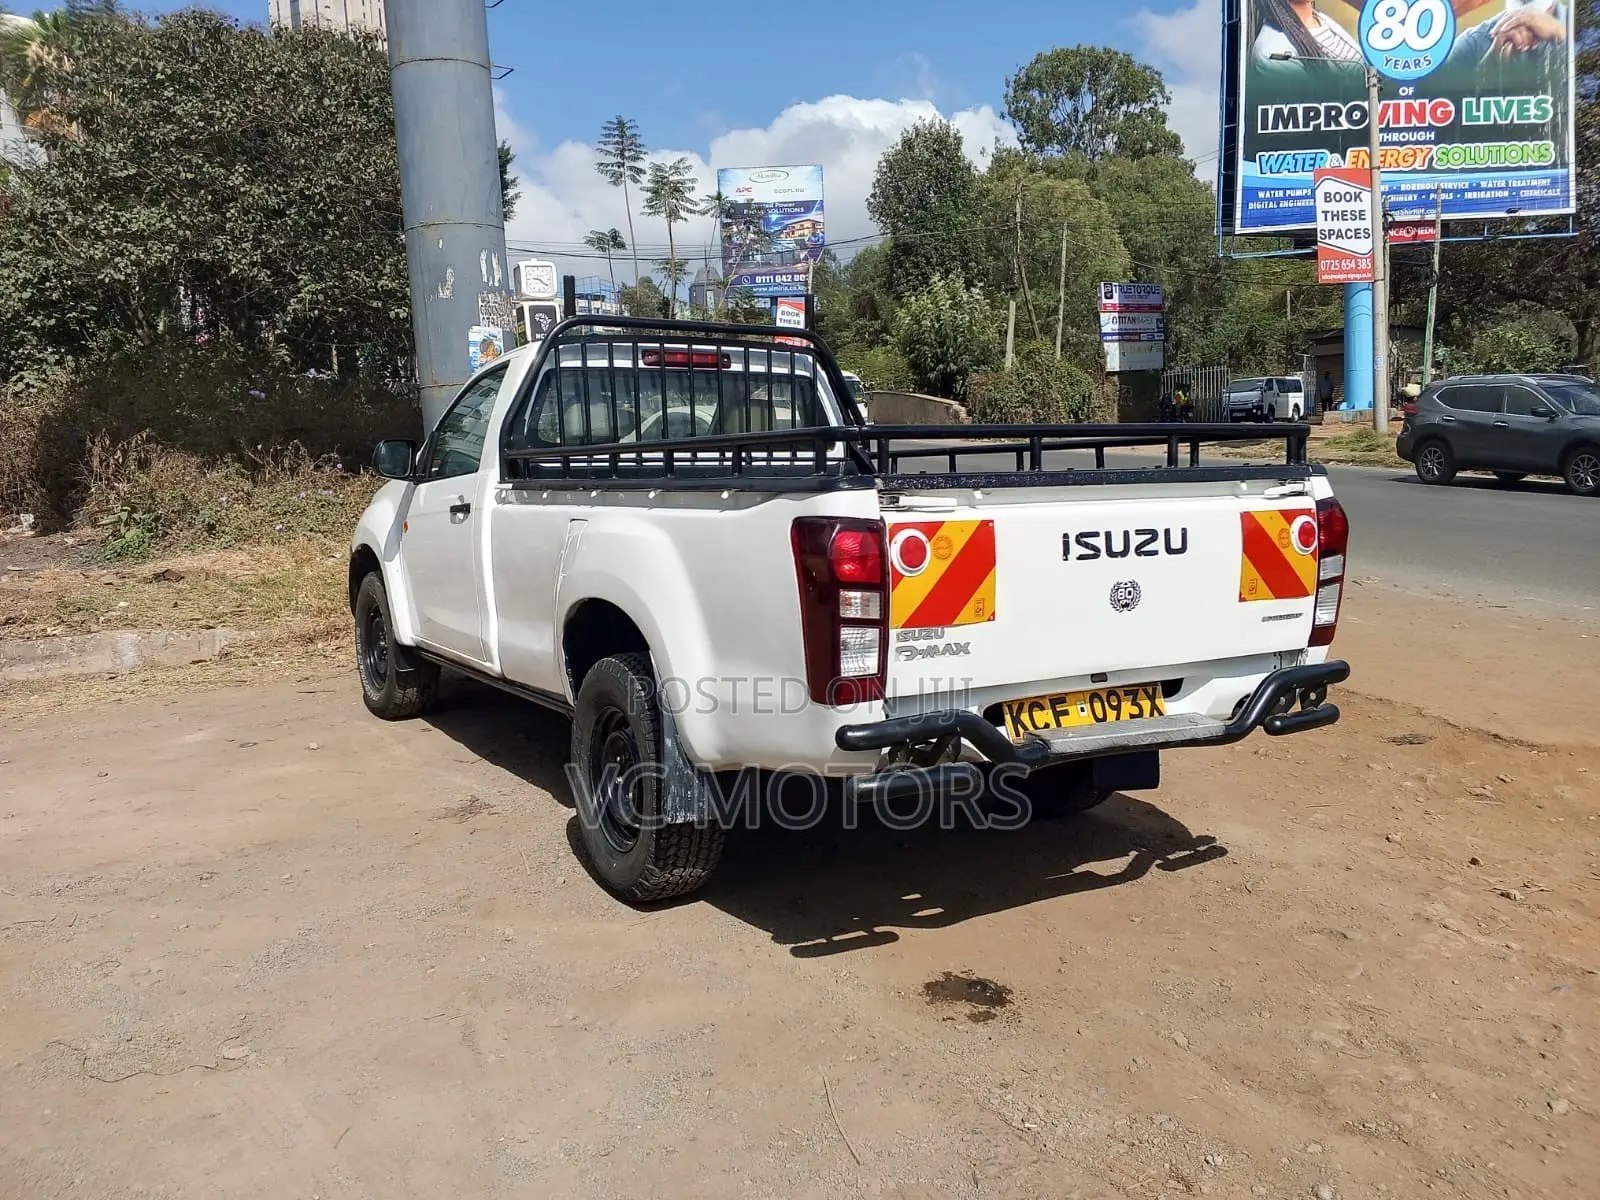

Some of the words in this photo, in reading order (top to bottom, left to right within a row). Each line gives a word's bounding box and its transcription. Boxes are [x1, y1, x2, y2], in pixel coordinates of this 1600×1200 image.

[1367, 0, 1449, 51] 80
[1383, 54, 1432, 71] YEARS
[1398, 86, 1415, 97] OF
[1463, 96, 1554, 124] LIVES
[1379, 131, 1435, 142] THROUGH
[1258, 151, 1329, 174] WATER
[1330, 154, 1342, 167] &
[1347, 147, 1432, 169] ENERGY
[1436, 143, 1554, 167] SOLUTIONS
[1257, 190, 1284, 199] WATER
[1285, 188, 1312, 197] PUMPS
[1480, 180, 1506, 188] WATER
[1248, 200, 1278, 209] DIGITAL
[1429, 192, 1454, 200] POLS
[1464, 190, 1509, 199] IRRIGATION
[1520, 188, 1560, 197] CHEMICALS
[1323, 191, 1363, 203] BOOK
[1321, 209, 1367, 222] THESE
[1319, 228, 1371, 240] SPACES
[1320, 259, 1340, 271] 0725
[1341, 259, 1356, 271] 654
[1357, 258, 1372, 270] 385
[755, 275, 774, 284] 0111
[775, 274, 793, 283] 042
[780, 309, 801, 318] BOOK
[778, 317, 801, 326] THESE
[1062, 527, 1188, 562] ISUZU
[896, 627, 946, 643] ISUZU
[1006, 695, 1071, 739] KCF
[1088, 686, 1166, 724] 093X
